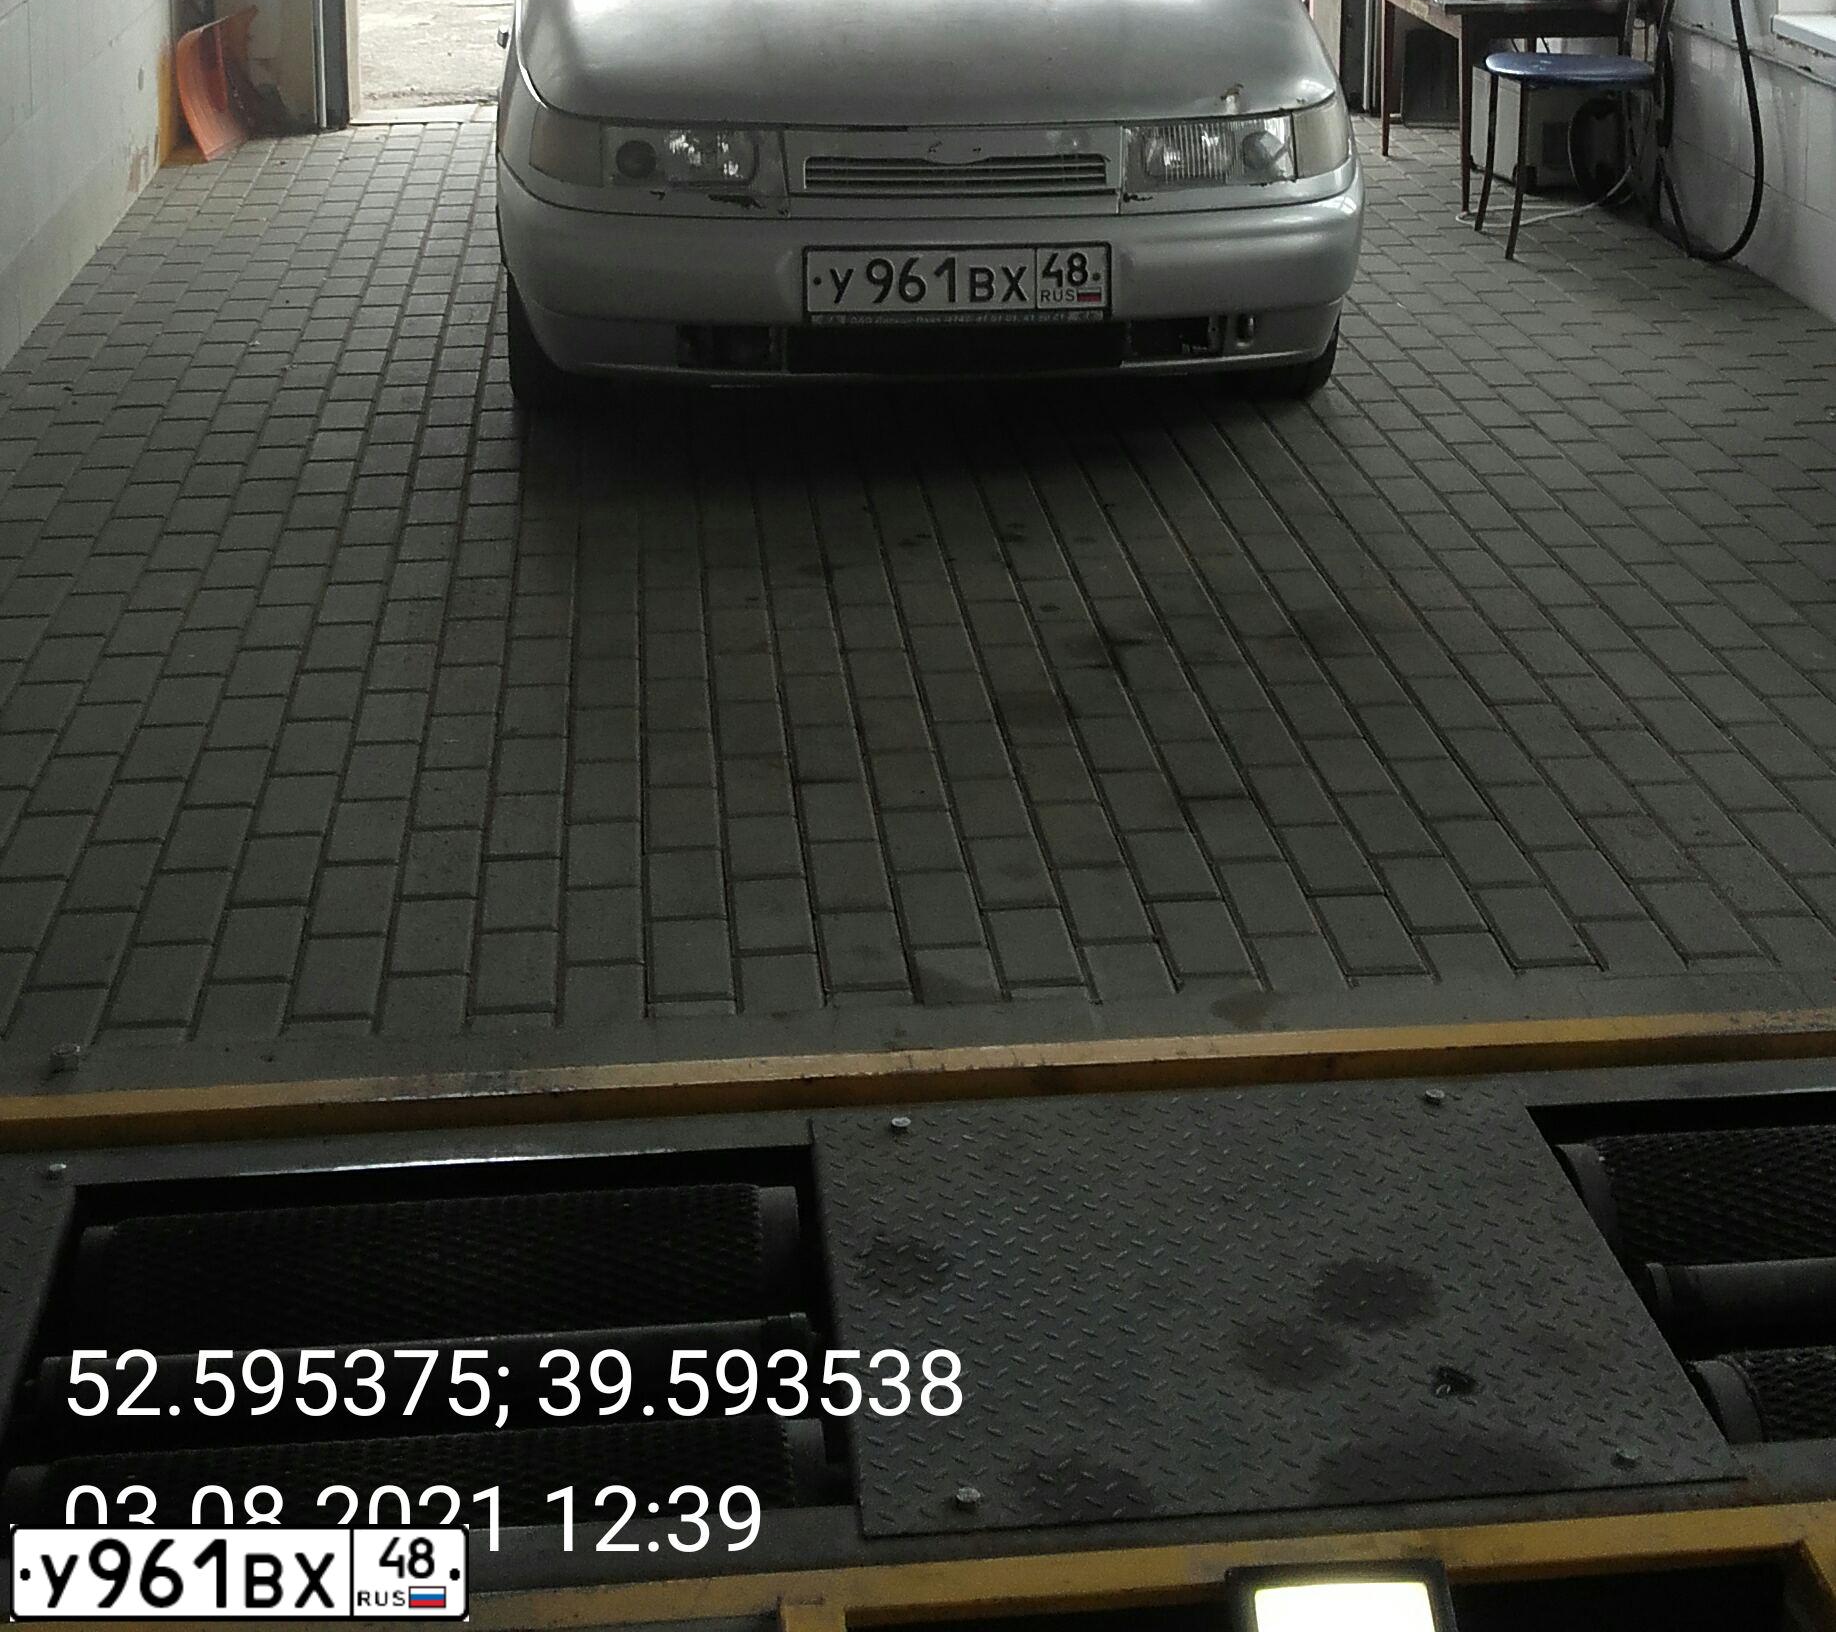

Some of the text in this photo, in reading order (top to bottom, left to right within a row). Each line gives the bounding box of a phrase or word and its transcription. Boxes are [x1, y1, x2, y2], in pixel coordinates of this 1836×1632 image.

[829, 252, 1089, 304] У961ВХ 48
[1040, 289, 1076, 302] RUS
